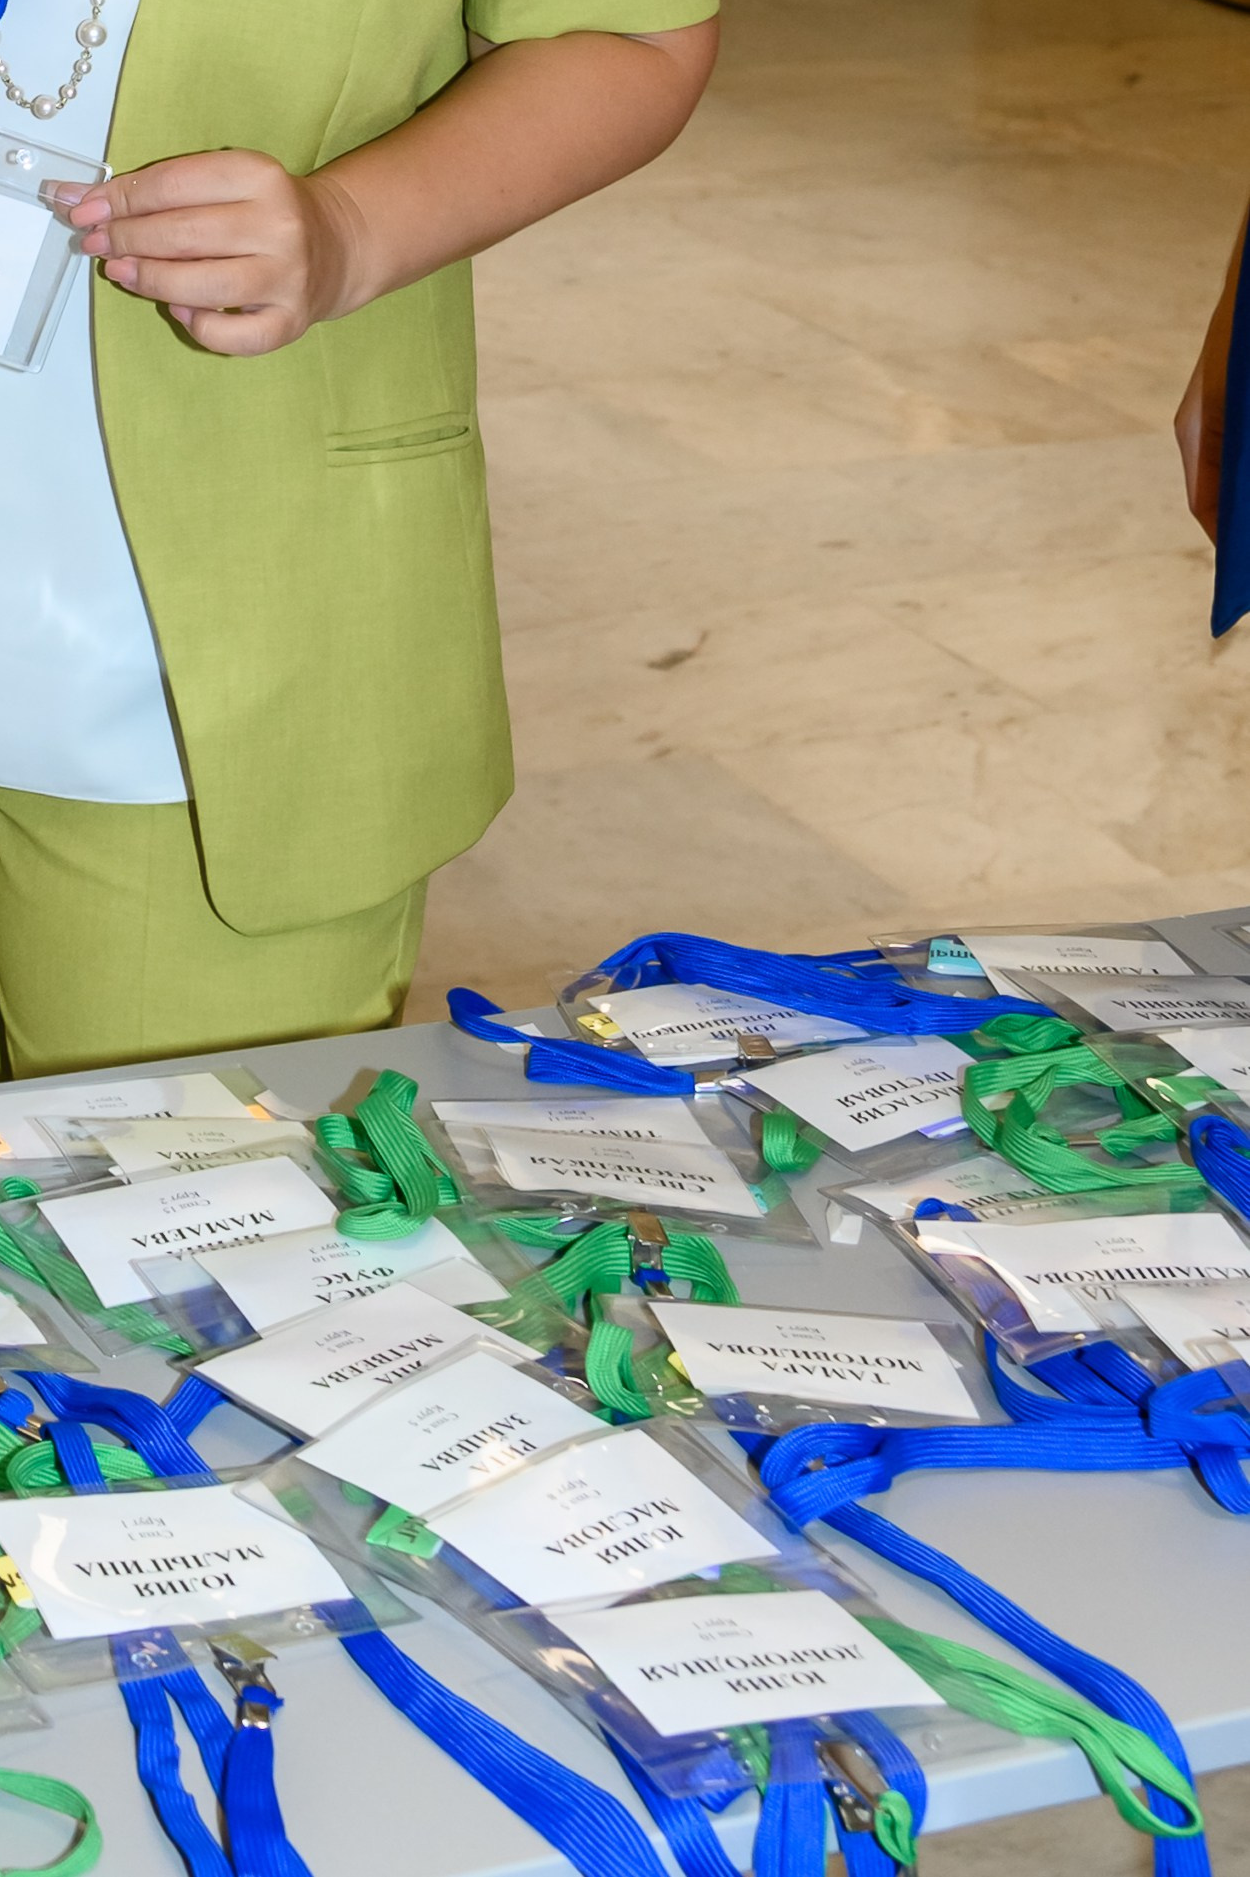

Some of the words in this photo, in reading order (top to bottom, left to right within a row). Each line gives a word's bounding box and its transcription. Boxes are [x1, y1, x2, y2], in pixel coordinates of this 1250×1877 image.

[1109, 999, 1247, 1011] ДУБРОВИНА
[835, 1070, 955, 1108] ПУСТОВАЯ
[847, 1084, 964, 1127] НАСТАСИЯ
[551, 1167, 705, 1193] СВЕТЛАНА
[130, 1209, 276, 1248] МАМАЕВА
[309, 1266, 395, 1289] ФУКС
[1023, 1265, 1250, 1286] КАЛАШНИКОВА
[308, 1332, 444, 1390] МАТВЕЕВА
[705, 1340, 925, 1374] МОТОВИЛОВА
[759, 1359, 891, 1387] ТАМАРА
[418, 1411, 532, 1472] ЗАЙЦЕВА
[543, 1496, 681, 1556] МАСЛОВА
[71, 1544, 266, 1578] МАЛЫГИНА
[594, 1524, 683, 1565] ЮЛИЯ
[131, 1571, 237, 1598] ЮЛИЯ
[638, 1643, 864, 1682] ДОБРОРОДНАЯ
[724, 1671, 828, 1693] ЮЛИЯ
